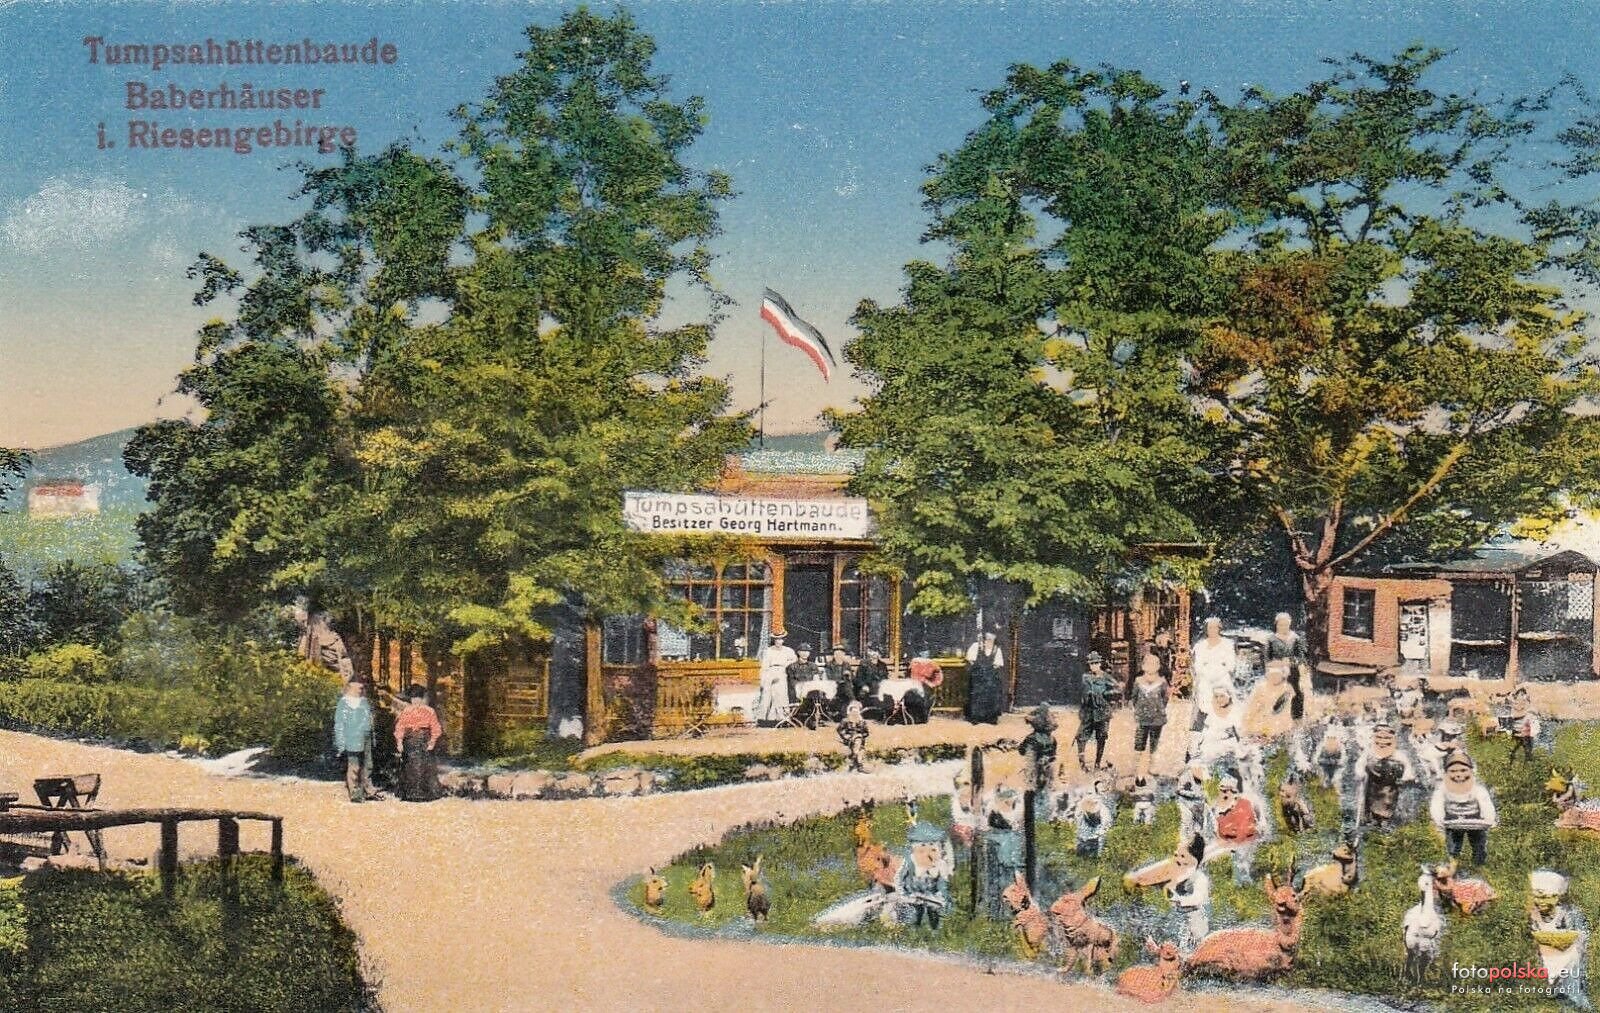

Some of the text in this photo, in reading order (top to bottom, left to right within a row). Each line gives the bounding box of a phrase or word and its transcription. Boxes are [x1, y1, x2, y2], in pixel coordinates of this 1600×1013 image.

[652, 515, 843, 533] Besitzer Georg Hartmann.
